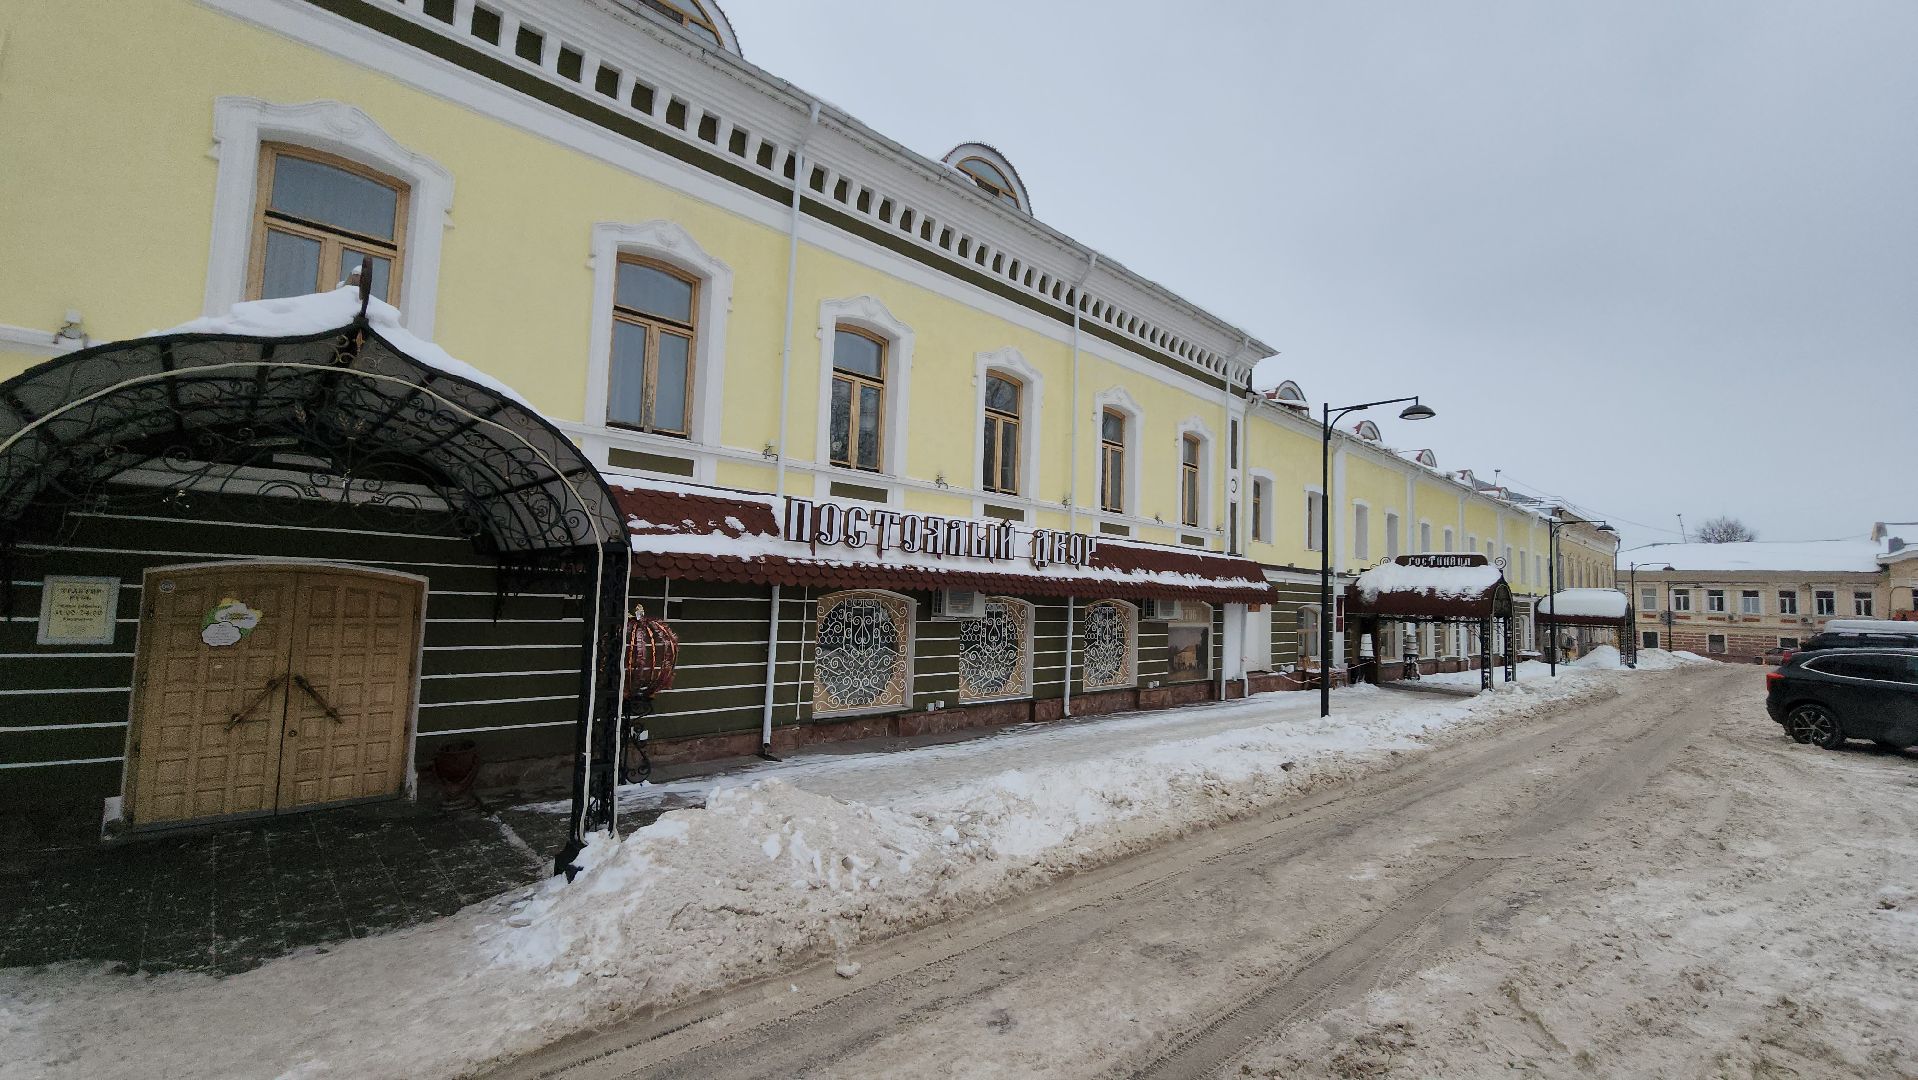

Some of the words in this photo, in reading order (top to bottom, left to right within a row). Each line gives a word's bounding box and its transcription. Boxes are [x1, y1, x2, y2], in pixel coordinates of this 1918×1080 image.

[785, 498, 1016, 561] ПОСТОЯЛЫЙ
[1031, 529, 1097, 568] ДВОР
[1408, 556, 1471, 567] ГОСТИНИЦА
